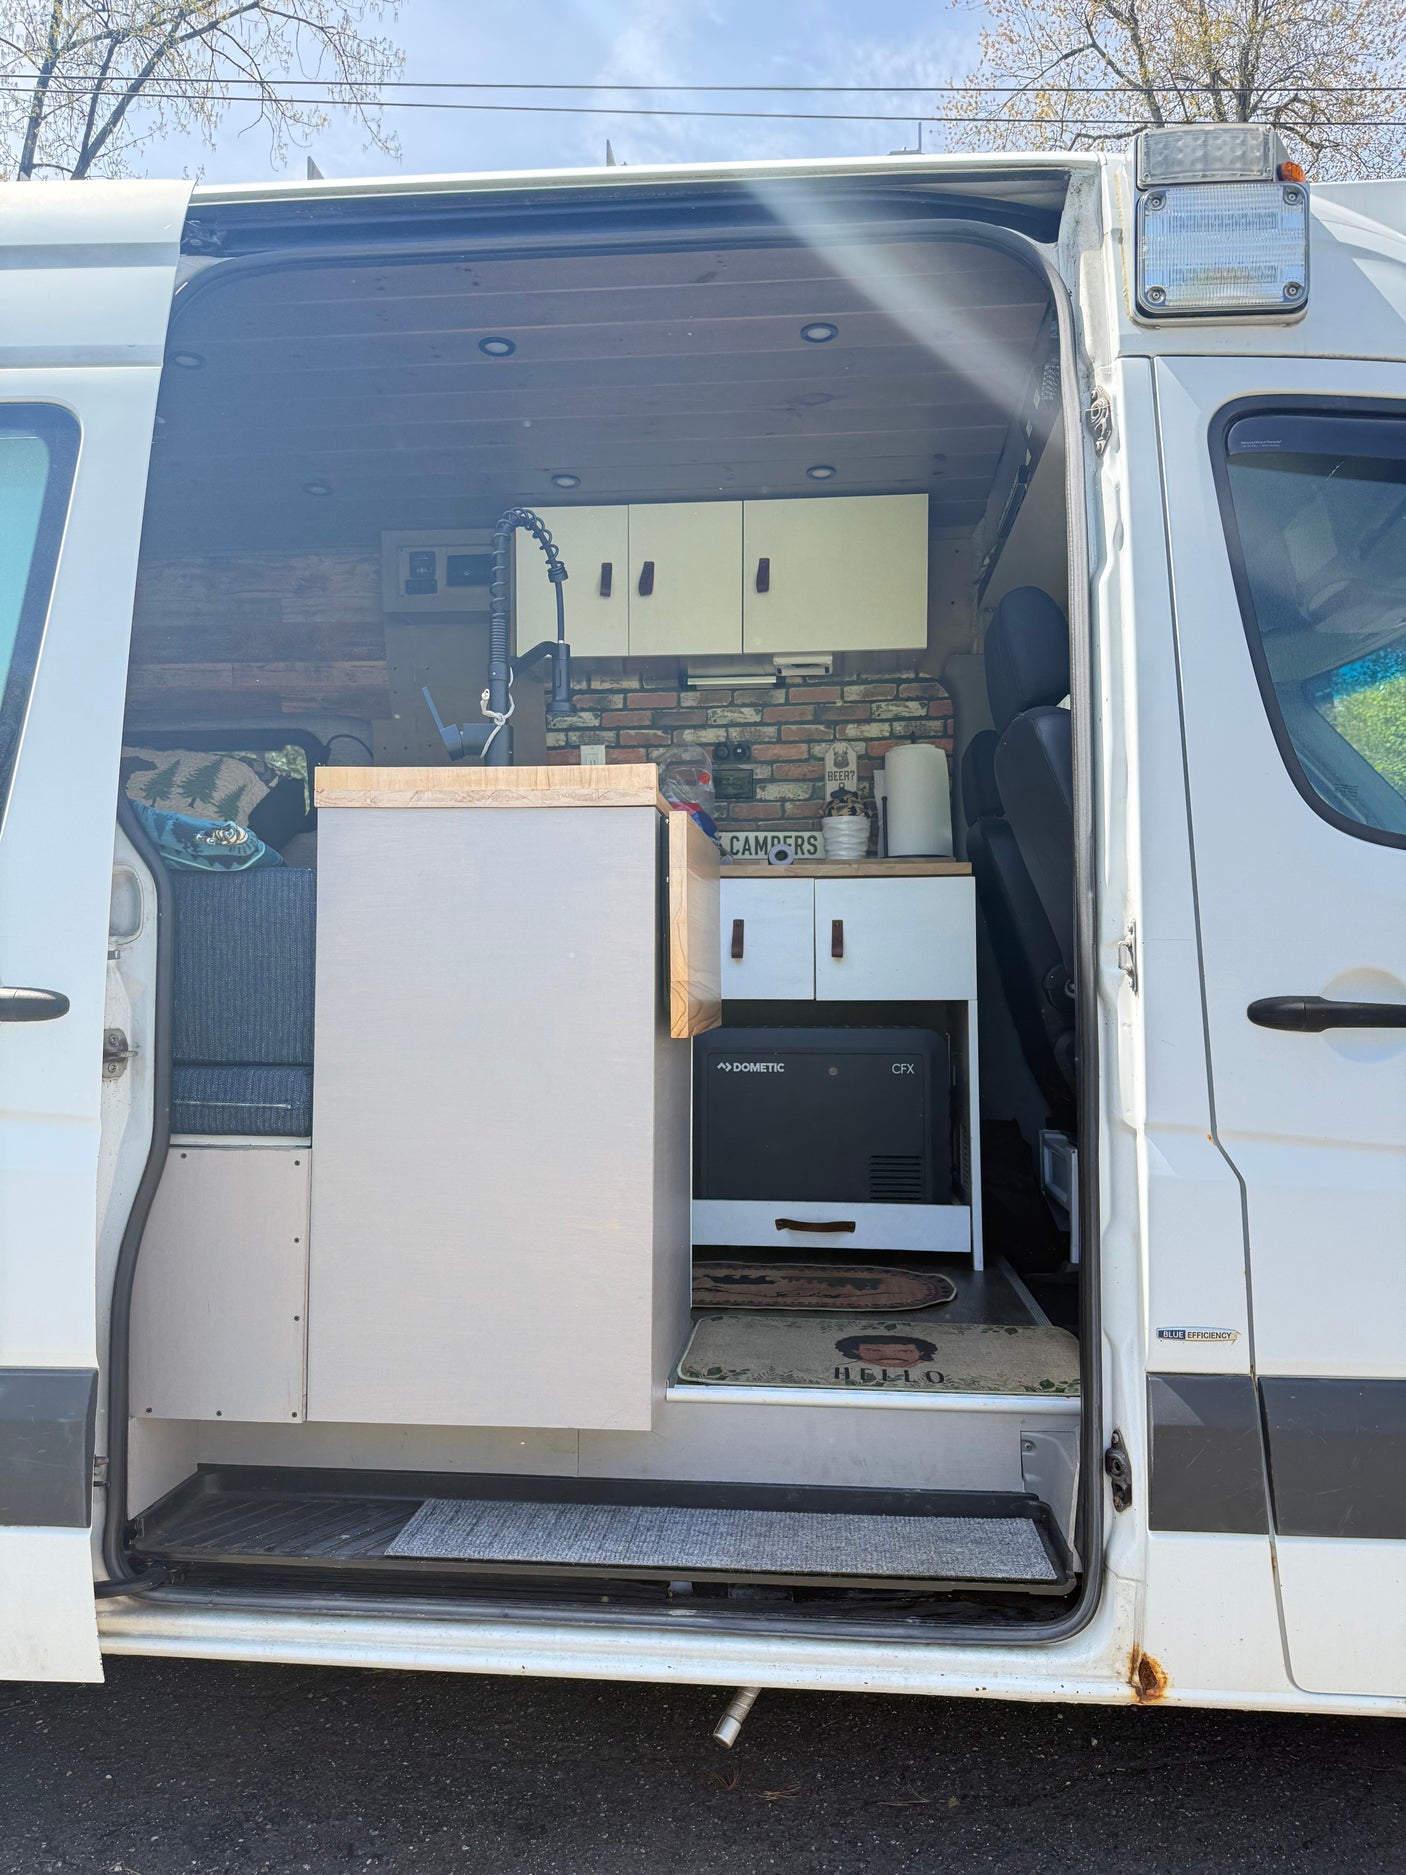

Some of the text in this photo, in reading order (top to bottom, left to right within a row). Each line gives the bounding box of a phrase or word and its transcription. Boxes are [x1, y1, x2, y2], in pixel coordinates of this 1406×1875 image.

[827, 770, 855, 781] BEER?
[733, 1062, 785, 1073] DOMETIC
[891, 1063, 915, 1074] CFX
[1162, 1331, 1232, 1339] BLUE EFFICIENCY
[834, 1367, 945, 1384] HELLO
